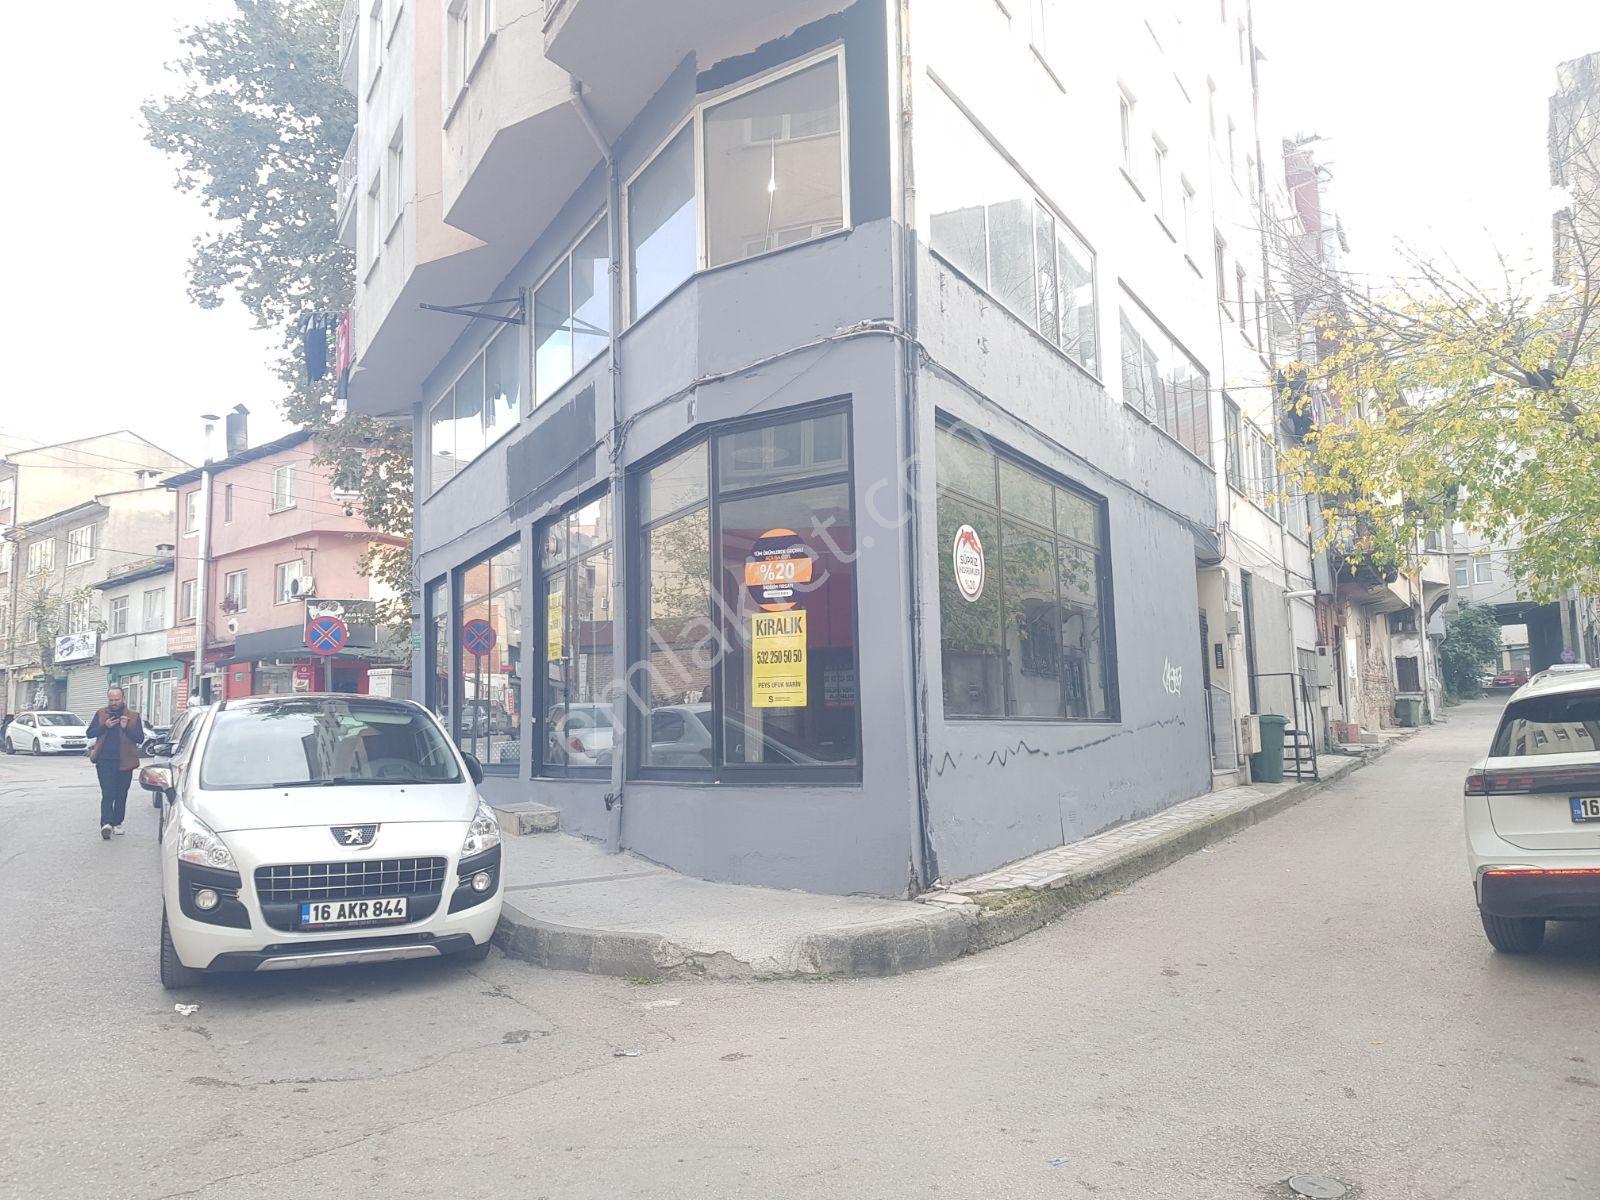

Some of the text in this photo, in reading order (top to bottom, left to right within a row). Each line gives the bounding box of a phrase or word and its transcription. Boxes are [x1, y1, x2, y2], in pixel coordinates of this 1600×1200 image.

[760, 562, 795, 581] %20
[756, 649, 802, 665] 532 250 50 50
[1581, 799, 1600, 816] 16
[313, 904, 331, 921] 16
[337, 902, 369, 919] AKR
[372, 899, 404, 917] 844
